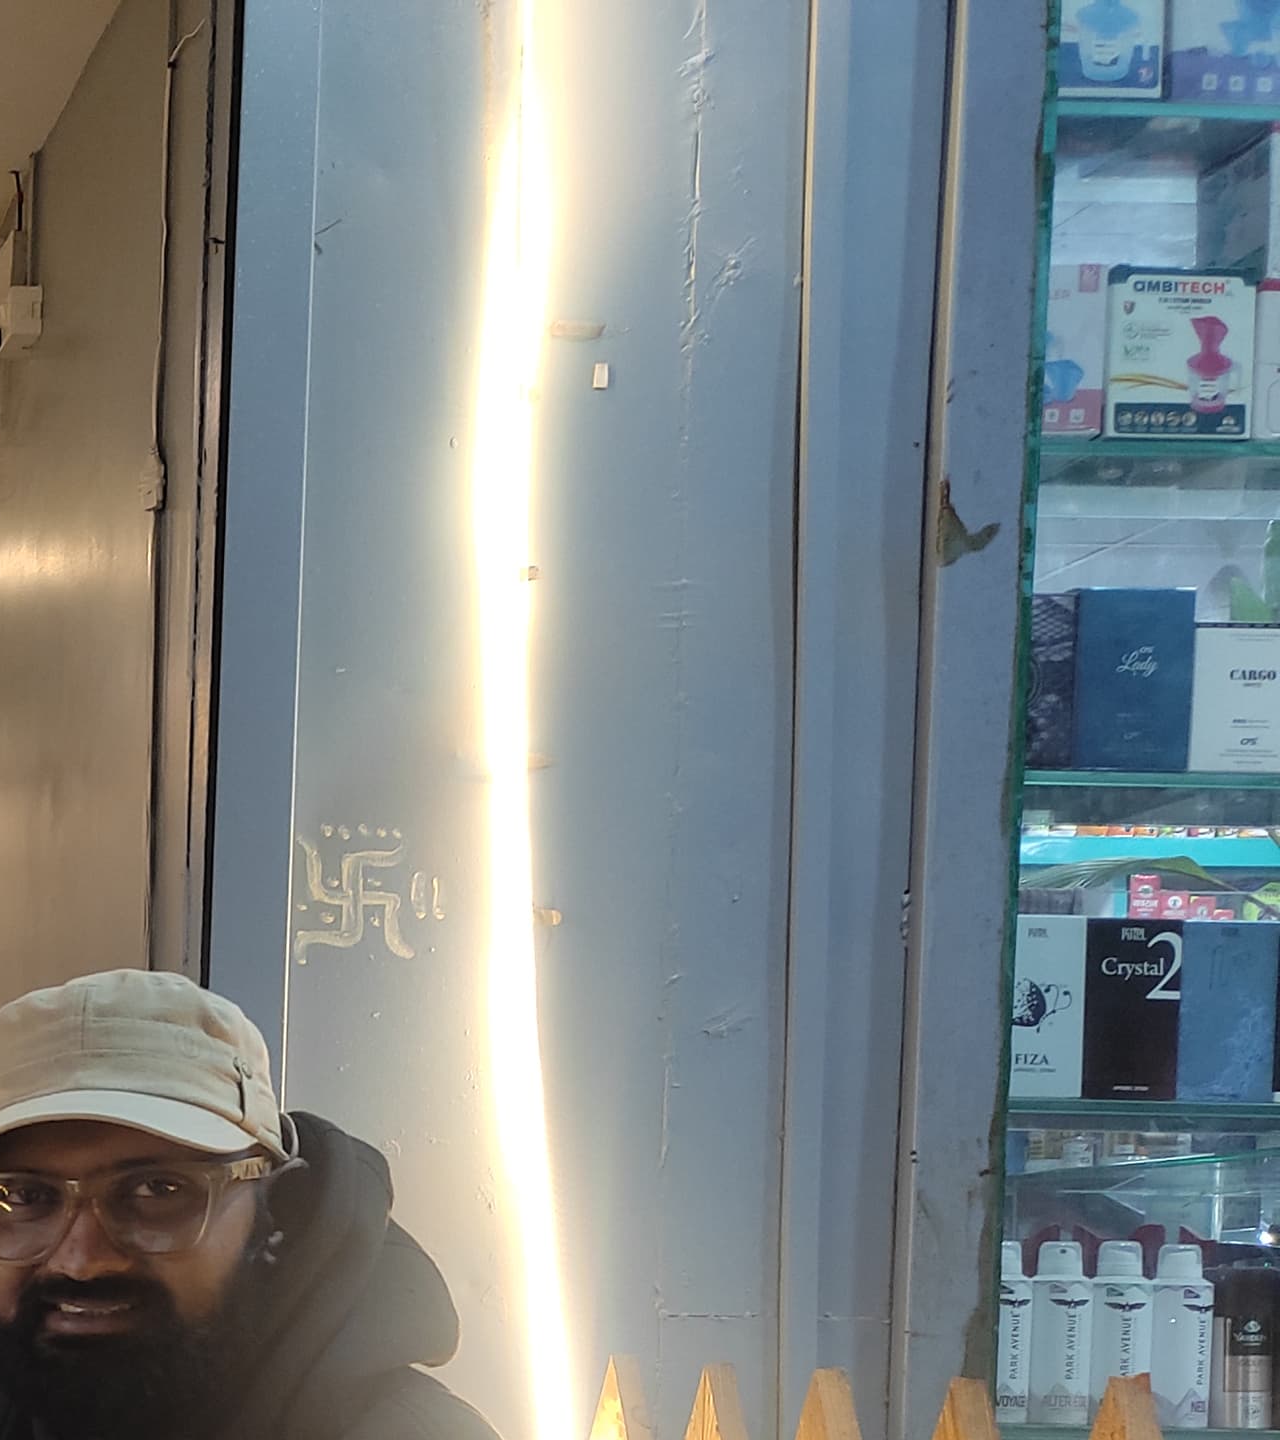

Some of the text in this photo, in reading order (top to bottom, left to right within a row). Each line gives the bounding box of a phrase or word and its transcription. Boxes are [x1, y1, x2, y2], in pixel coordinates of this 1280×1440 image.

[1229, 669, 1277, 681] CARGO
[1101, 956, 1165, 981] Crystal
[1145, 931, 1183, 1000] 2
[1014, 1053, 1049, 1065] FIZA
[1009, 1312, 1021, 1380] PARK AVENUE
[1065, 1313, 1077, 1380] PARK AVENUE
[1119, 1316, 1132, 1377] ARK AVENUE
[1196, 1319, 1207, 1386] PARK AVENUE
